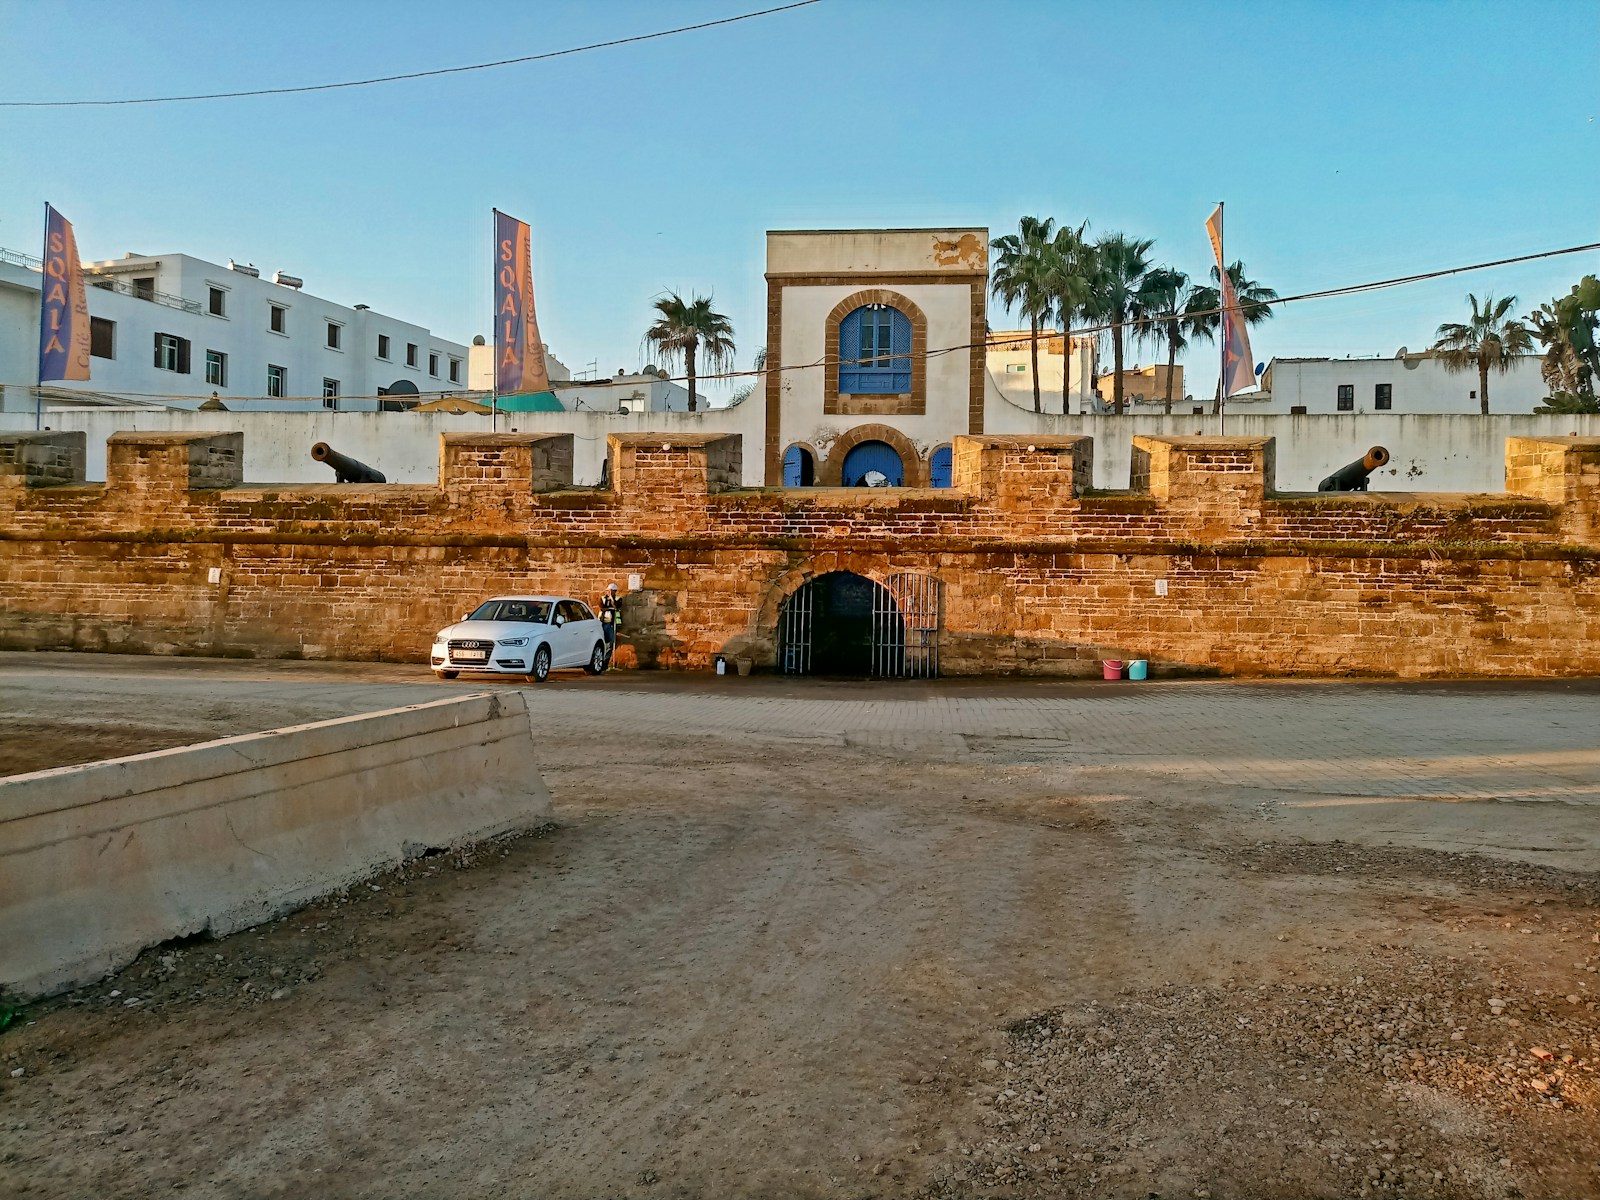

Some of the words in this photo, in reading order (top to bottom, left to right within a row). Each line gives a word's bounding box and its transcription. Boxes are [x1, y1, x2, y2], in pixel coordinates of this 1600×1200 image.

[44, 232, 67, 354] SQALA
[500, 239, 520, 368] SQALA
[76, 332, 90, 369] Café
[529, 342, 544, 377] Café
